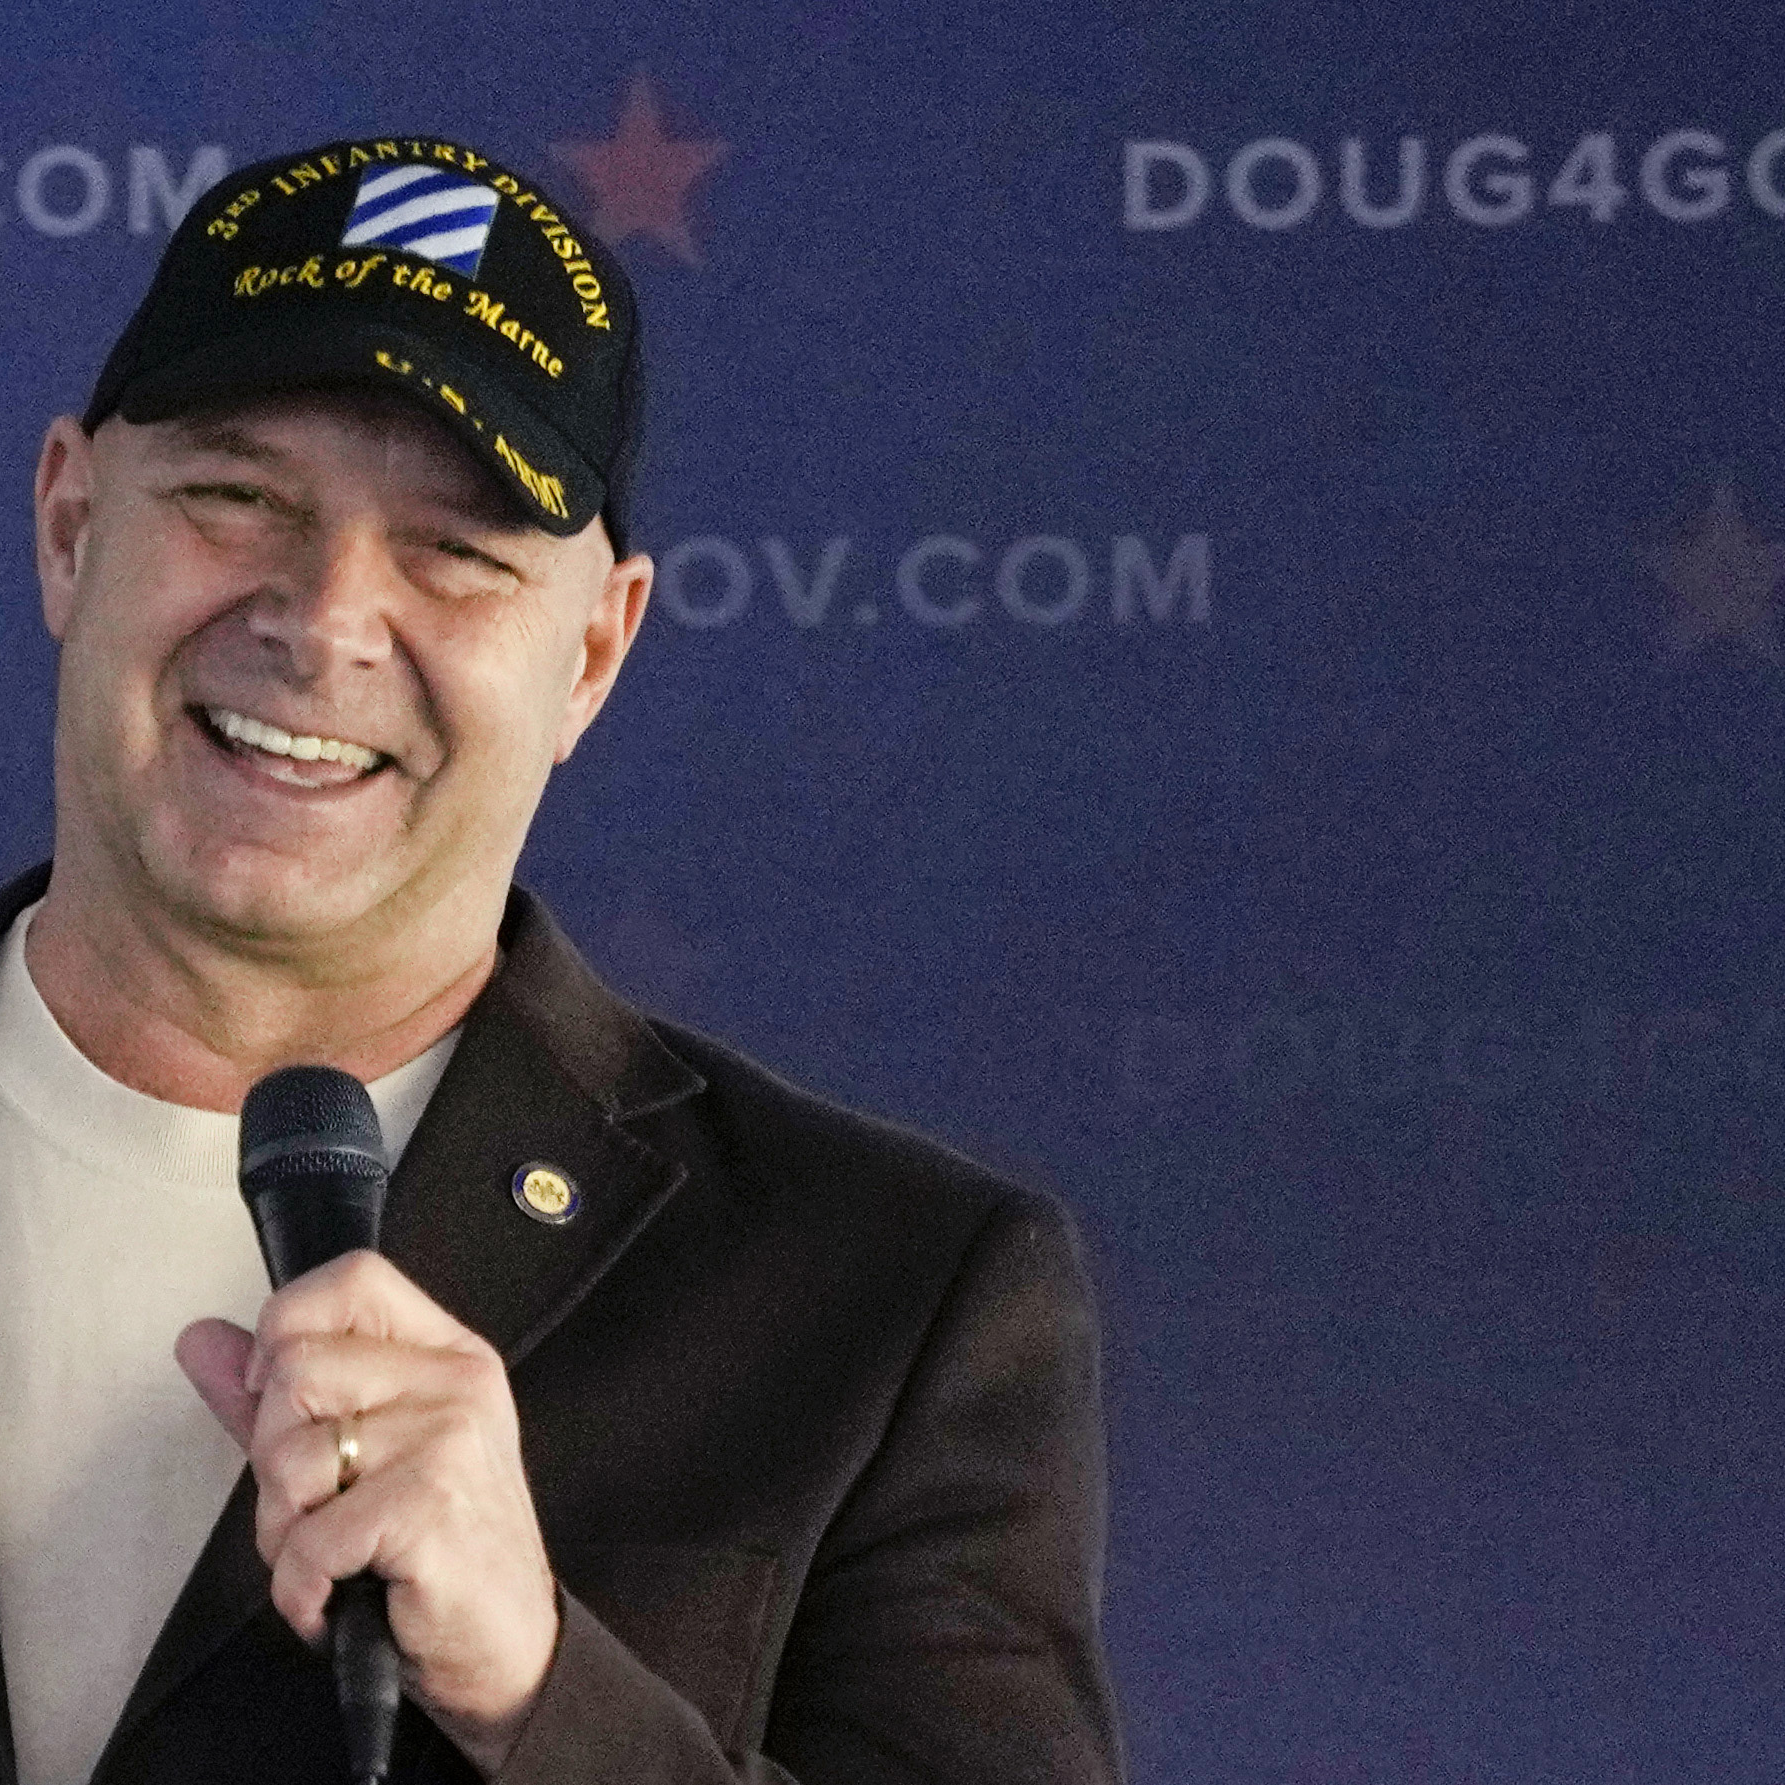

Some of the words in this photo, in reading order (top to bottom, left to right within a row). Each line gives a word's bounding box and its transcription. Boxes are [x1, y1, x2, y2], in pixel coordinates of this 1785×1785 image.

[234, 254, 326, 298] Rock
[334, 252, 387, 290] of
[392, 264, 453, 302] the
[463, 289, 564, 380] Marne
[271, 140, 489, 197] INFANTRY
[491, 174, 611, 332] DIVISION
